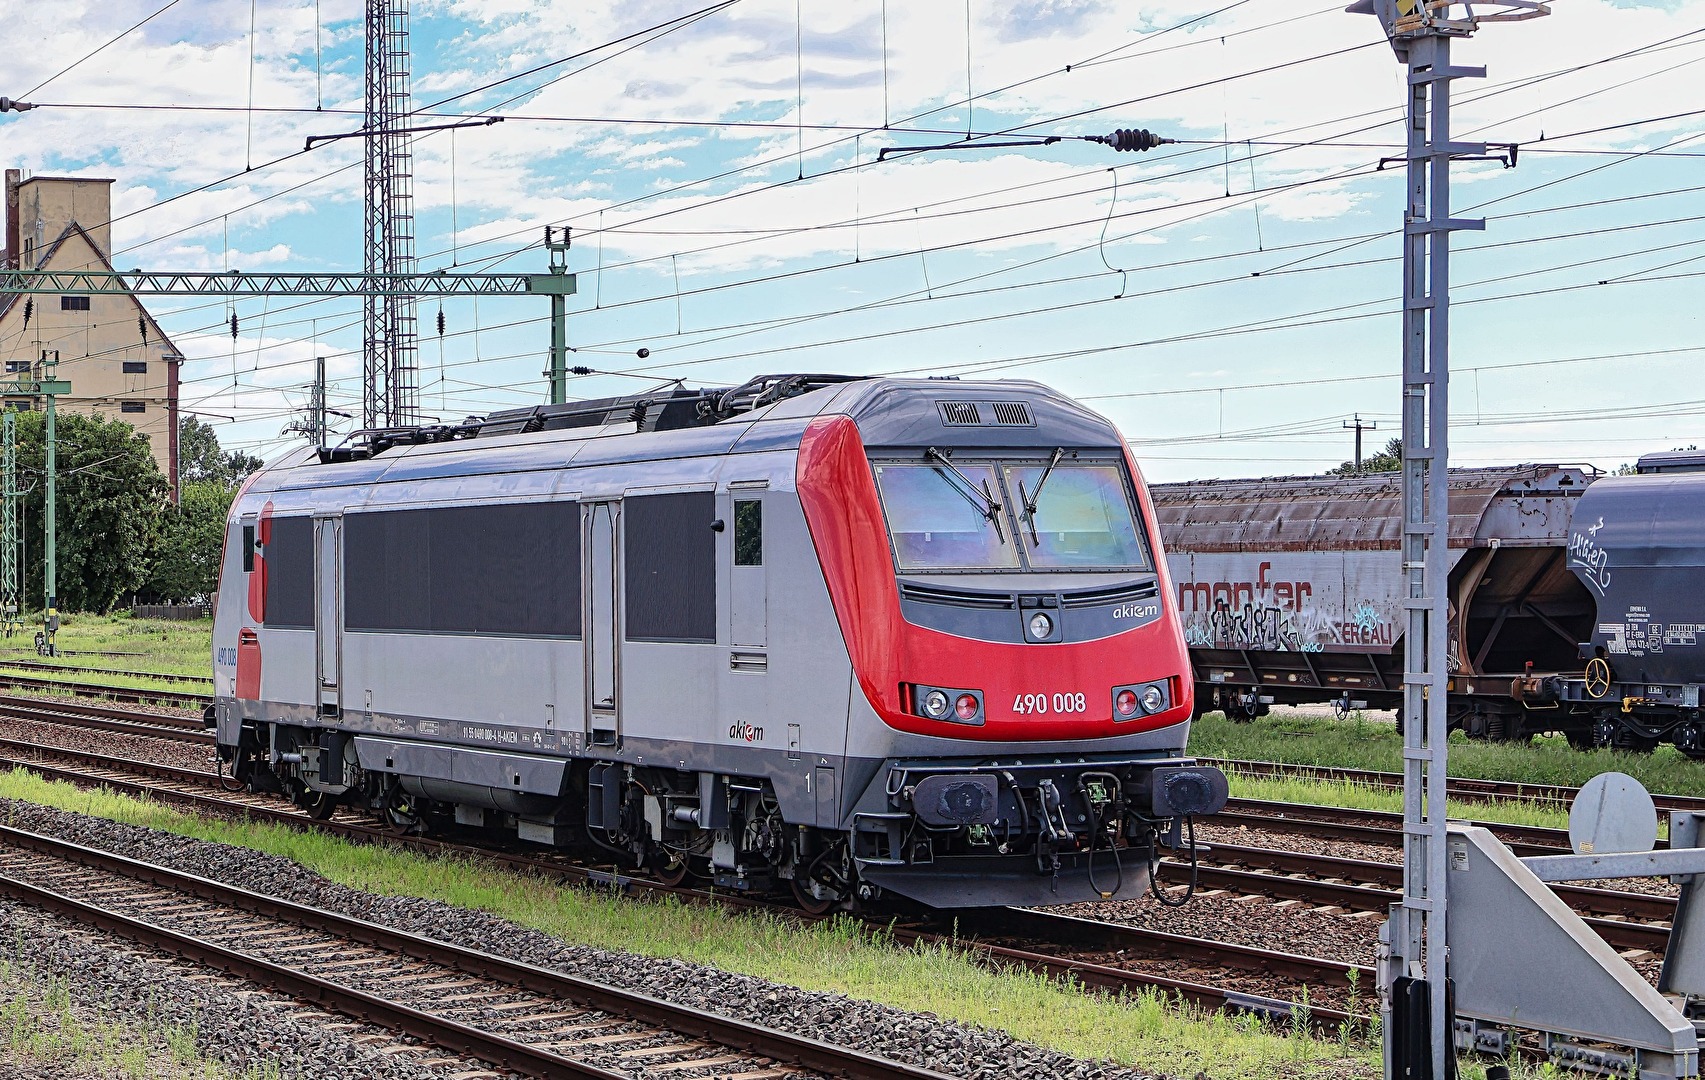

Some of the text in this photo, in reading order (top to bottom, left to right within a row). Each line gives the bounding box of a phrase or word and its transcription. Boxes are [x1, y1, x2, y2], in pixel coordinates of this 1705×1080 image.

[1113, 604, 1158, 619] akiem
[1012, 692, 1087, 715] 490 008
[729, 719, 764, 742] akiem
[805, 772, 811, 793] 1
